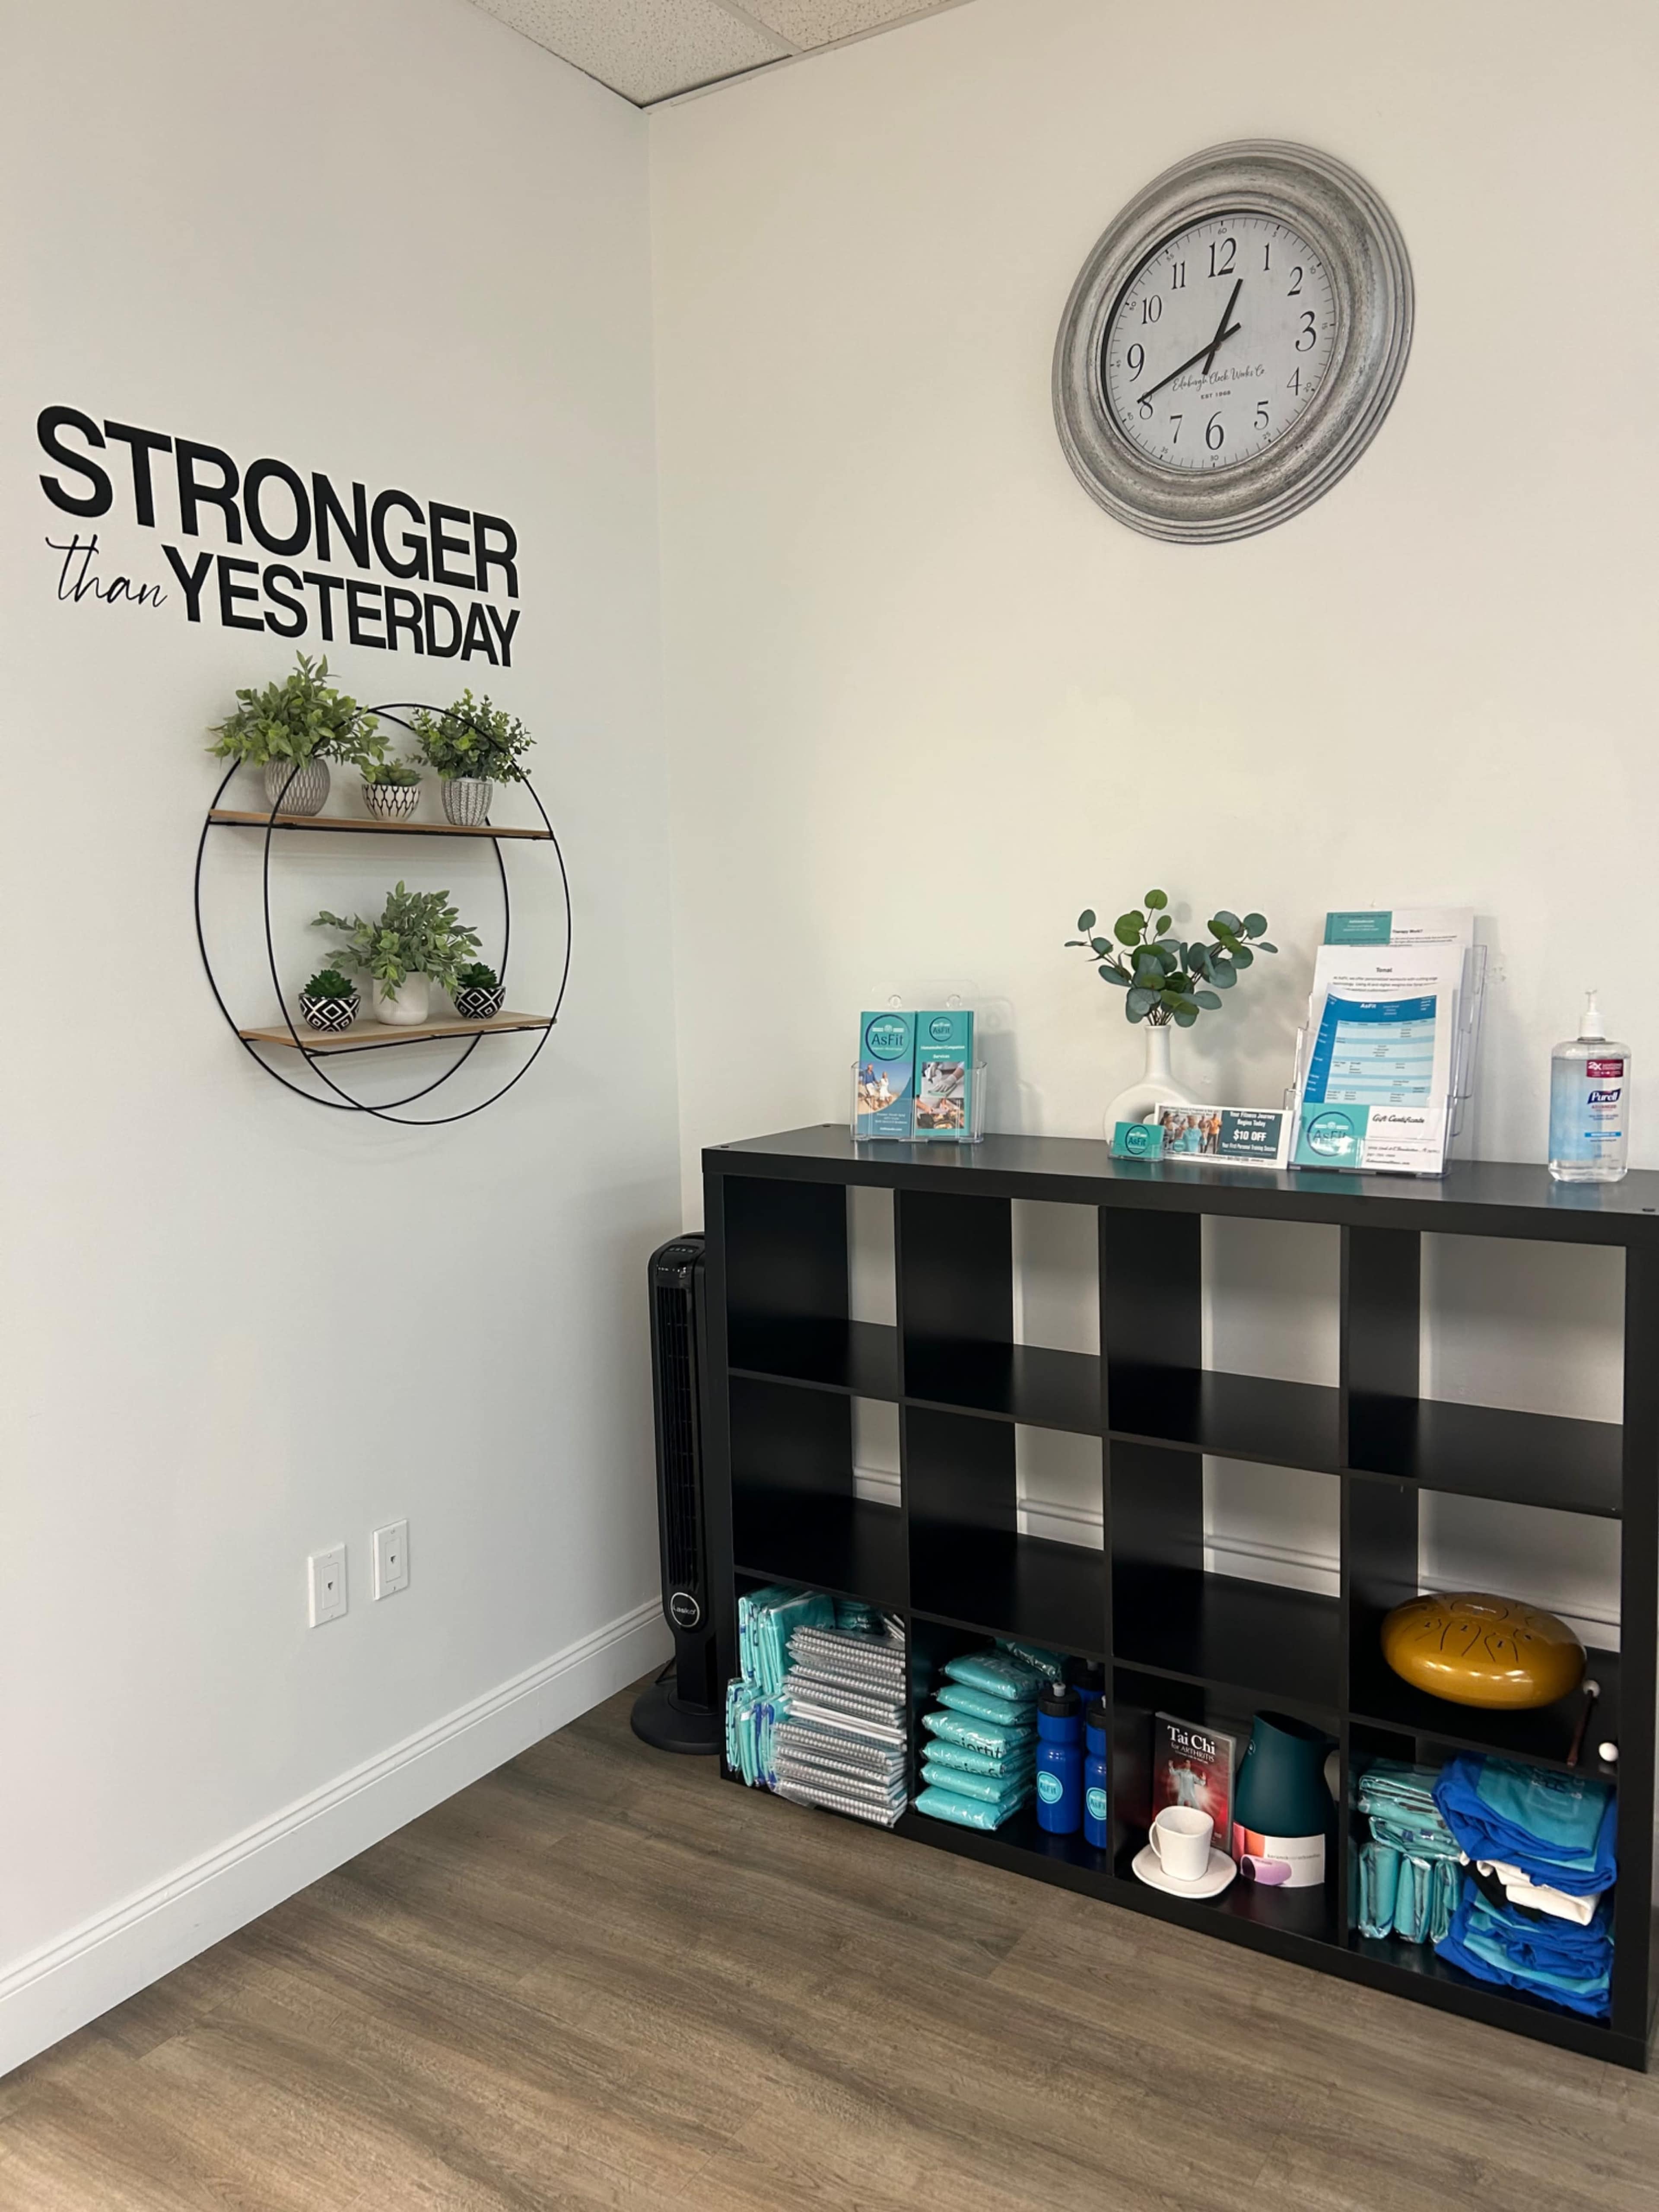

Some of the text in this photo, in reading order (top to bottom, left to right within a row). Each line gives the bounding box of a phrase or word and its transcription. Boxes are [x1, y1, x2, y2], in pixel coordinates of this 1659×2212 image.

[1208, 238, 1236, 278] 12
[1264, 242, 1270, 271] 1
[1171, 261, 1186, 290] 11
[1287, 267, 1303, 296] 2
[1142, 295, 1162, 324] 10
[1295, 311, 1316, 352] 3
[1127, 343, 1145, 382] 9
[1210, 369, 1229, 384] Clock
[1231, 365, 1253, 380] Works
[1287, 367, 1303, 396] 4
[1140, 392, 1153, 420] 8
[1254, 400, 1269, 430] 5
[1170, 414, 1182, 444] 7
[1205, 411, 1224, 450] 6
[37, 406, 518, 598] STRONGER
[45, 534, 520, 667] than YESTERDAY
[871, 1033, 903, 1046] AsFit
[1373, 1113, 1425, 1123] Gift Certificate
[1128, 1137, 1146, 1146] AsFit
[1233, 1129, 1267, 1141] $10 OFF
[1167, 1725, 1215, 1755] Tai Chi
[1180, 1746, 1214, 1763] ARTHRITIS
